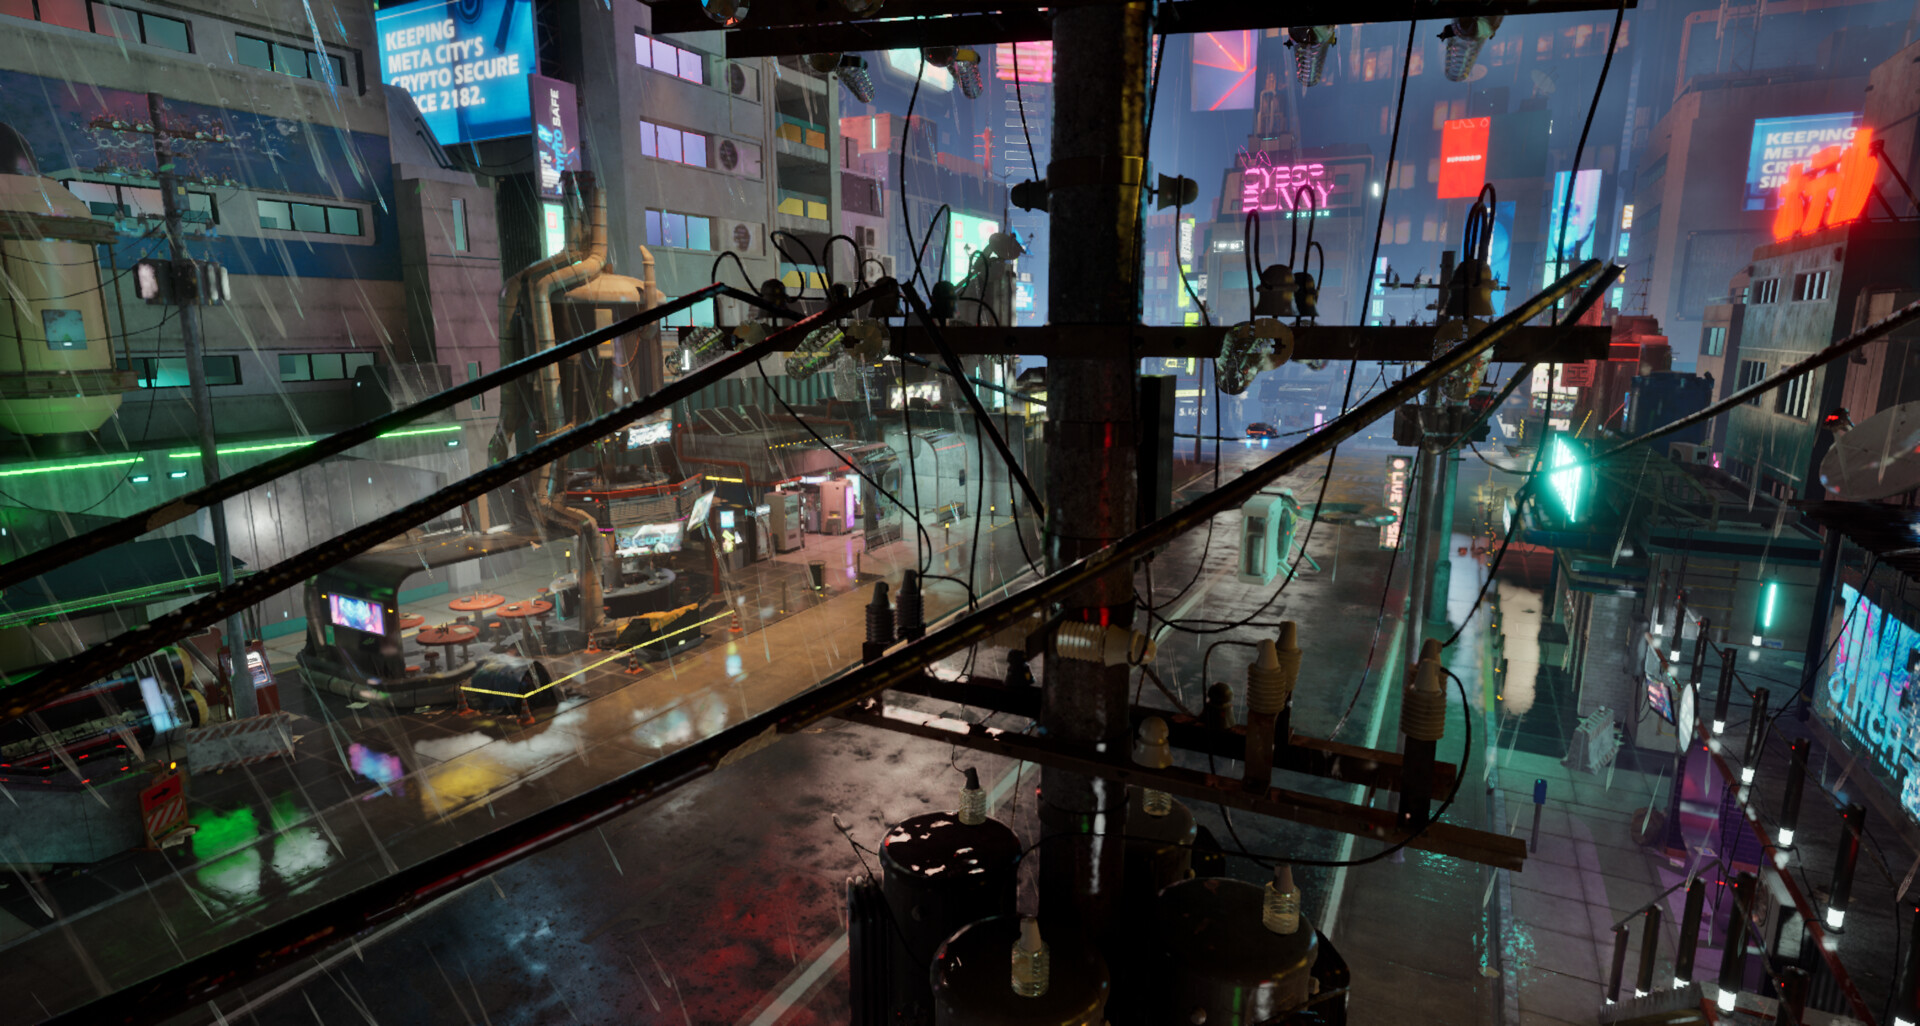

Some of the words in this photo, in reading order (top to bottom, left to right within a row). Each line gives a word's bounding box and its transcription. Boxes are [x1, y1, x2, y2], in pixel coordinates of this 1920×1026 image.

[386, 19, 455, 52] KEEPING
[388, 47, 433, 74] META
[435, 36, 484, 63] CITY'S
[455, 54, 520, 85] SECURE
[440, 86, 486, 111] 2182.
[550, 88, 561, 127] SAFE
[551, 129, 565, 174] RYPTO
[1766, 127, 1858, 146] KEEPING
[1244, 164, 1324, 190] CYBER
[1242, 181, 1335, 213] BUNNY
[1389, 471, 1405, 503] LIVE
